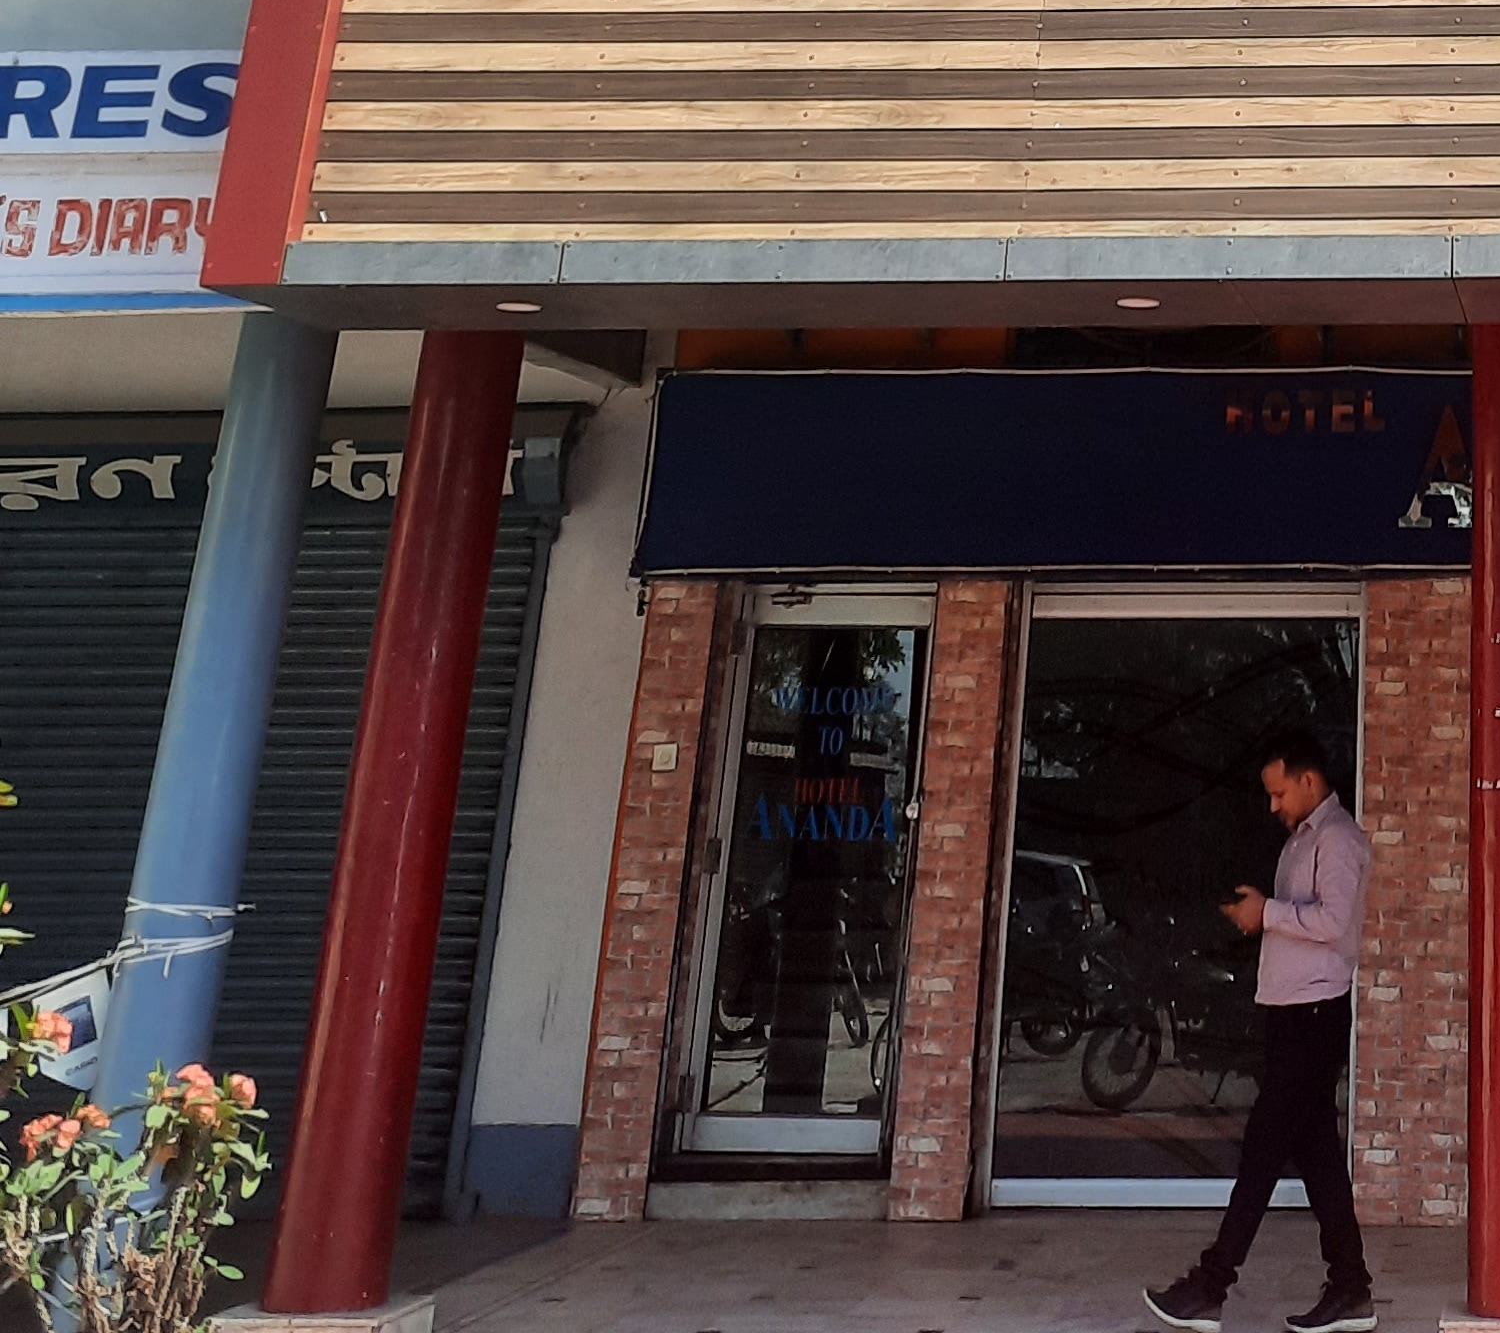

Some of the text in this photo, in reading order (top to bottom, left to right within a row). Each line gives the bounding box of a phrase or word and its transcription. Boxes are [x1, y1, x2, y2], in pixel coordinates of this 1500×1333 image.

[1225, 389, 1386, 435] HOTEL
[820, 726, 844, 756] TO
[744, 792, 898, 846] ANANDA
